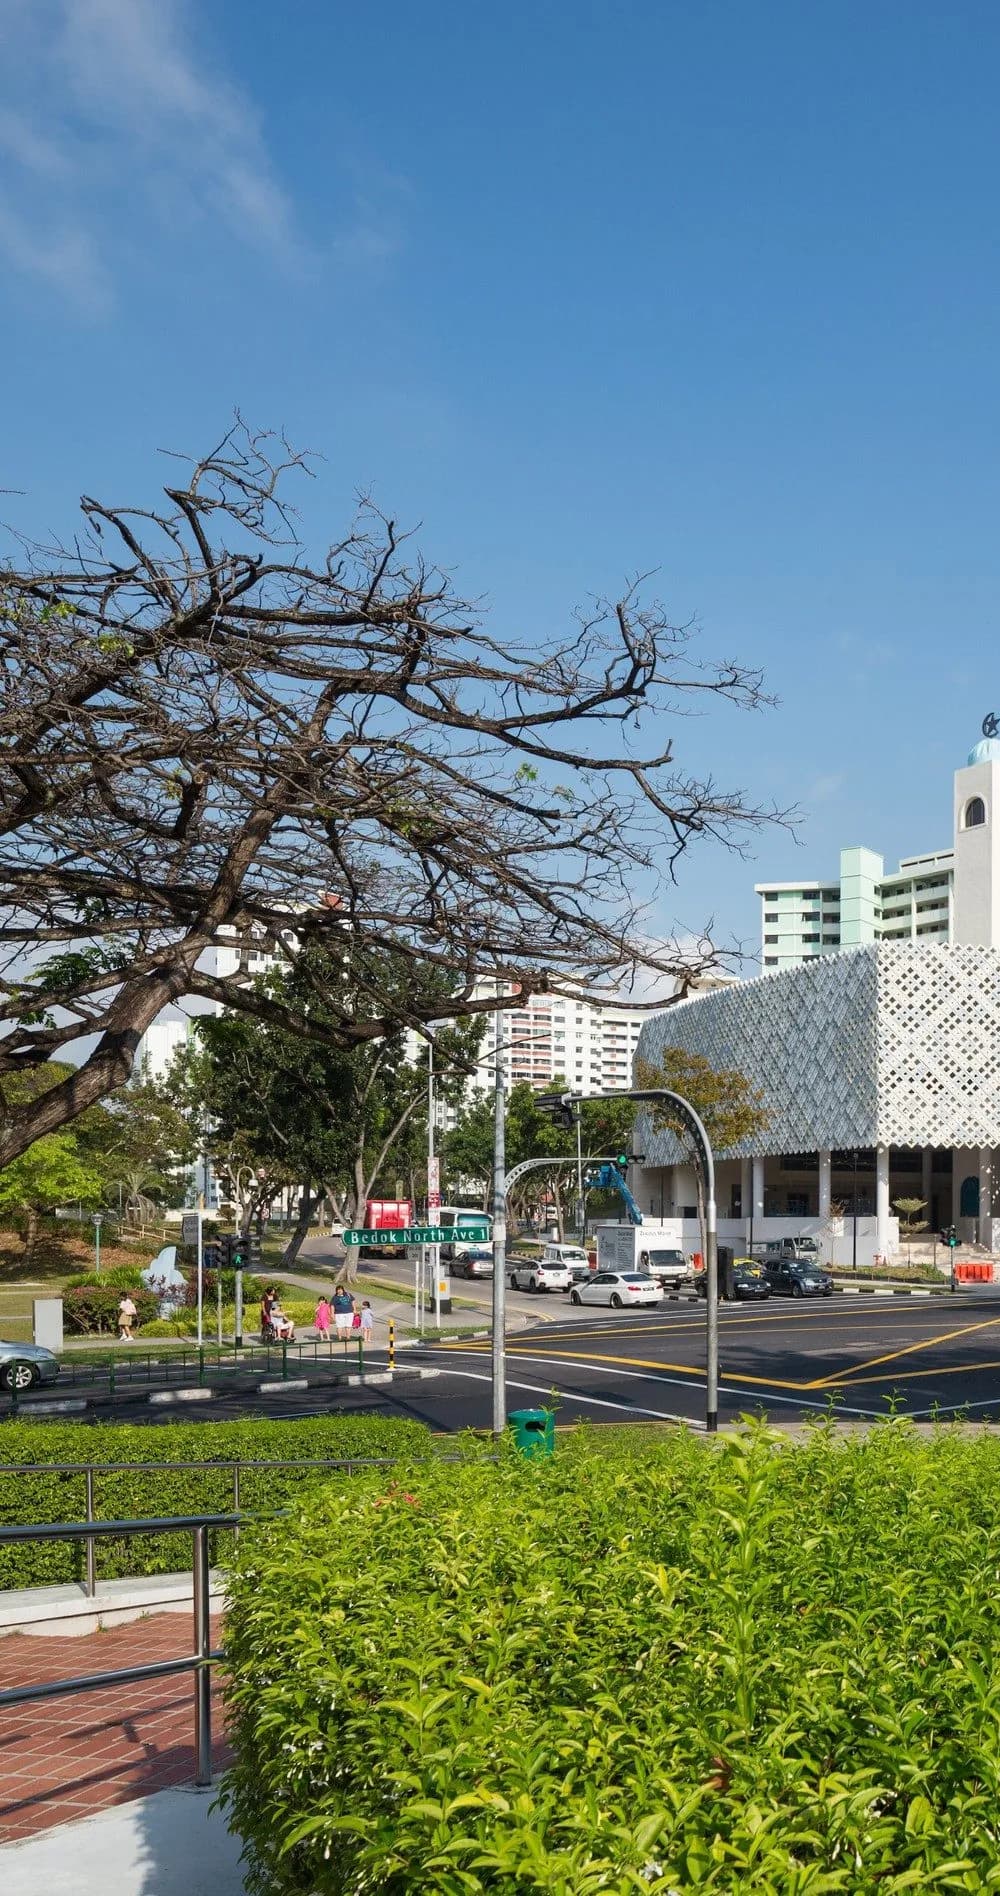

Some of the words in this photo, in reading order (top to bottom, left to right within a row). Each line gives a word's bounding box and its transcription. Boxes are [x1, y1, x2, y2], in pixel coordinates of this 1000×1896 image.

[351, 1231, 397, 1244] Bedok
[403, 1229, 444, 1242] North
[452, 1227, 474, 1241] Ave
[480, 1228, 486, 1240] 1
